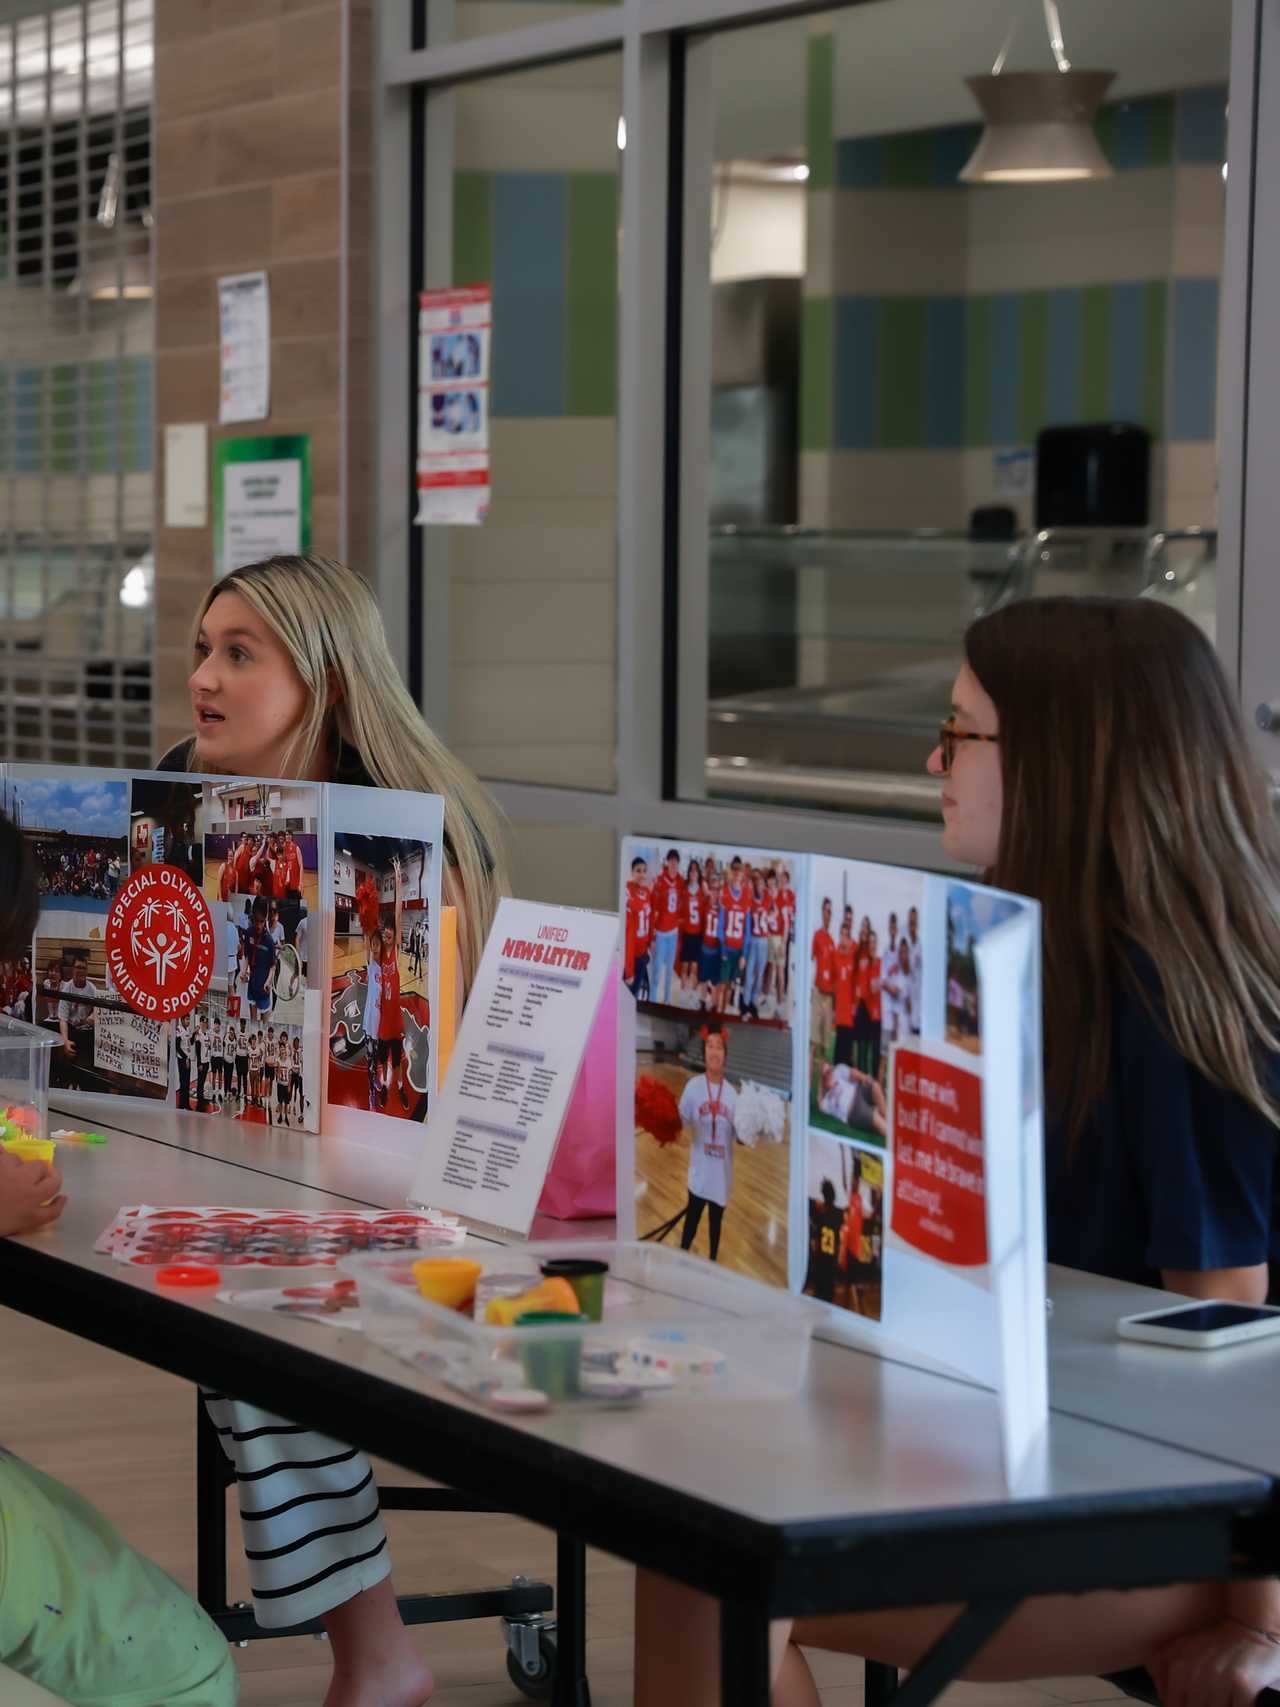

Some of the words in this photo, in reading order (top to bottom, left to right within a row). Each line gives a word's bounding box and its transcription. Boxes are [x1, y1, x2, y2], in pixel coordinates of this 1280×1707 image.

[112, 871, 157, 929] SPECIAL
[160, 870, 211, 944] OLYMPICS
[725, 910, 745, 938] 15
[536, 924, 569, 943] UNIFIED
[501, 937, 591, 971] NEWSLETTER
[110, 948, 158, 1011] UNIFIED
[162, 963, 209, 1013] SPORTS
[131, 1018, 160, 1044] DAVID
[131, 1053, 161, 1067] JAMES
[131, 1064, 160, 1080] LUKE
[897, 1066, 918, 1096] Let
[919, 1077, 937, 1103] me
[897, 1100, 919, 1134] but
[897, 1136, 914, 1168] let
[914, 1150, 933, 1175] me
